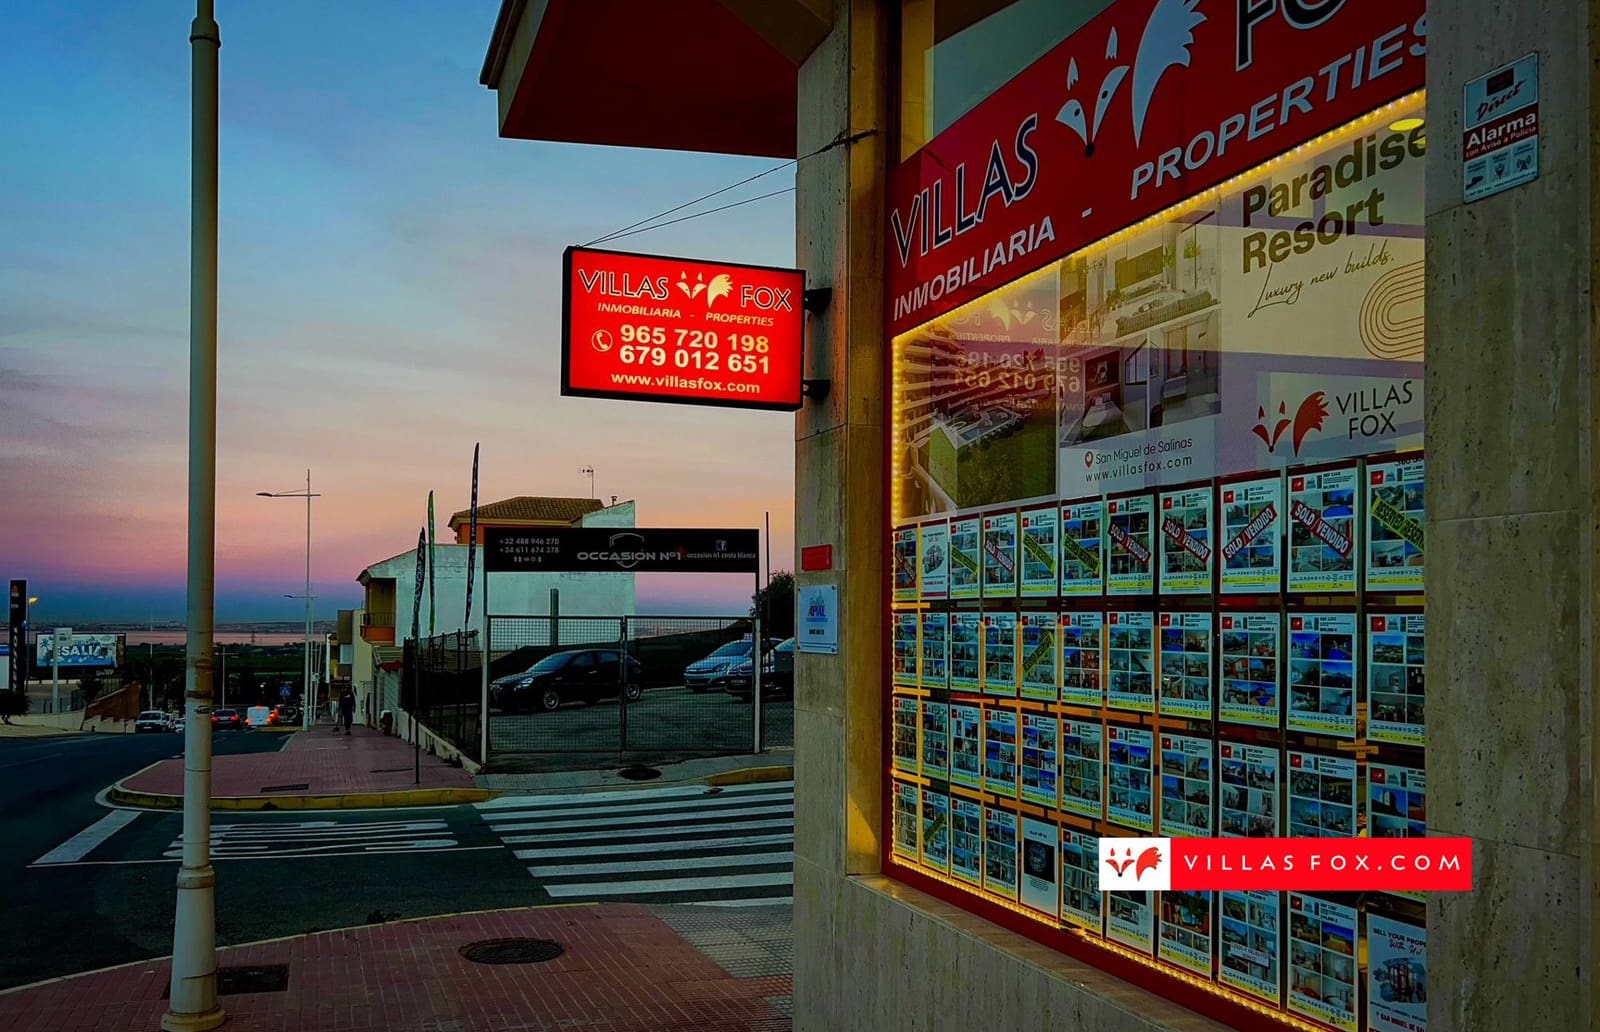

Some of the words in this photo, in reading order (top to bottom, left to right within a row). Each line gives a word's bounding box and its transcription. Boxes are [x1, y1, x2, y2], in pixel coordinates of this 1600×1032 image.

[1466, 113, 1537, 149] Alarma
[1465, 148, 1480, 158] con
[1480, 139, 1502, 152] Aviso
[891, 113, 1038, 269] VILLAS
[1243, 188, 1384, 274] Resort
[894, 216, 1055, 321] INMOBILIARIA
[578, 269, 668, 300] VILLAS
[740, 286, 792, 312] FOX
[1247, 262, 1305, 318] Luxury
[1310, 267, 1338, 285] new
[597, 303, 681, 318] INMOBILIARIA
[705, 312, 774, 327] PROPERTIES
[620, 324, 666, 345] 965
[674, 329, 718, 349] 720
[727, 334, 769, 353] 198
[619, 345, 666, 366] 679
[674, 350, 719, 371] 012
[727, 354, 769, 374] 651
[610, 372, 760, 394] www.villasfox.com
[1336, 380, 1412, 415] VILLAS
[1349, 411, 1396, 440] FOX
[1095, 453, 1112, 464] San
[1114, 445, 1141, 462] Miguel
[1143, 444, 1156, 455] de
[1158, 438, 1193, 453] Salinas
[1085, 456, 1192, 482] www.villasfox.com
[1224, 537, 1243, 558] SOLD
[1244, 508, 1273, 540] VENDIDO
[1295, 504, 1315, 526] SOLD
[1315, 521, 1349, 553] VENDIDO
[577, 552, 656, 560] OCCASION
